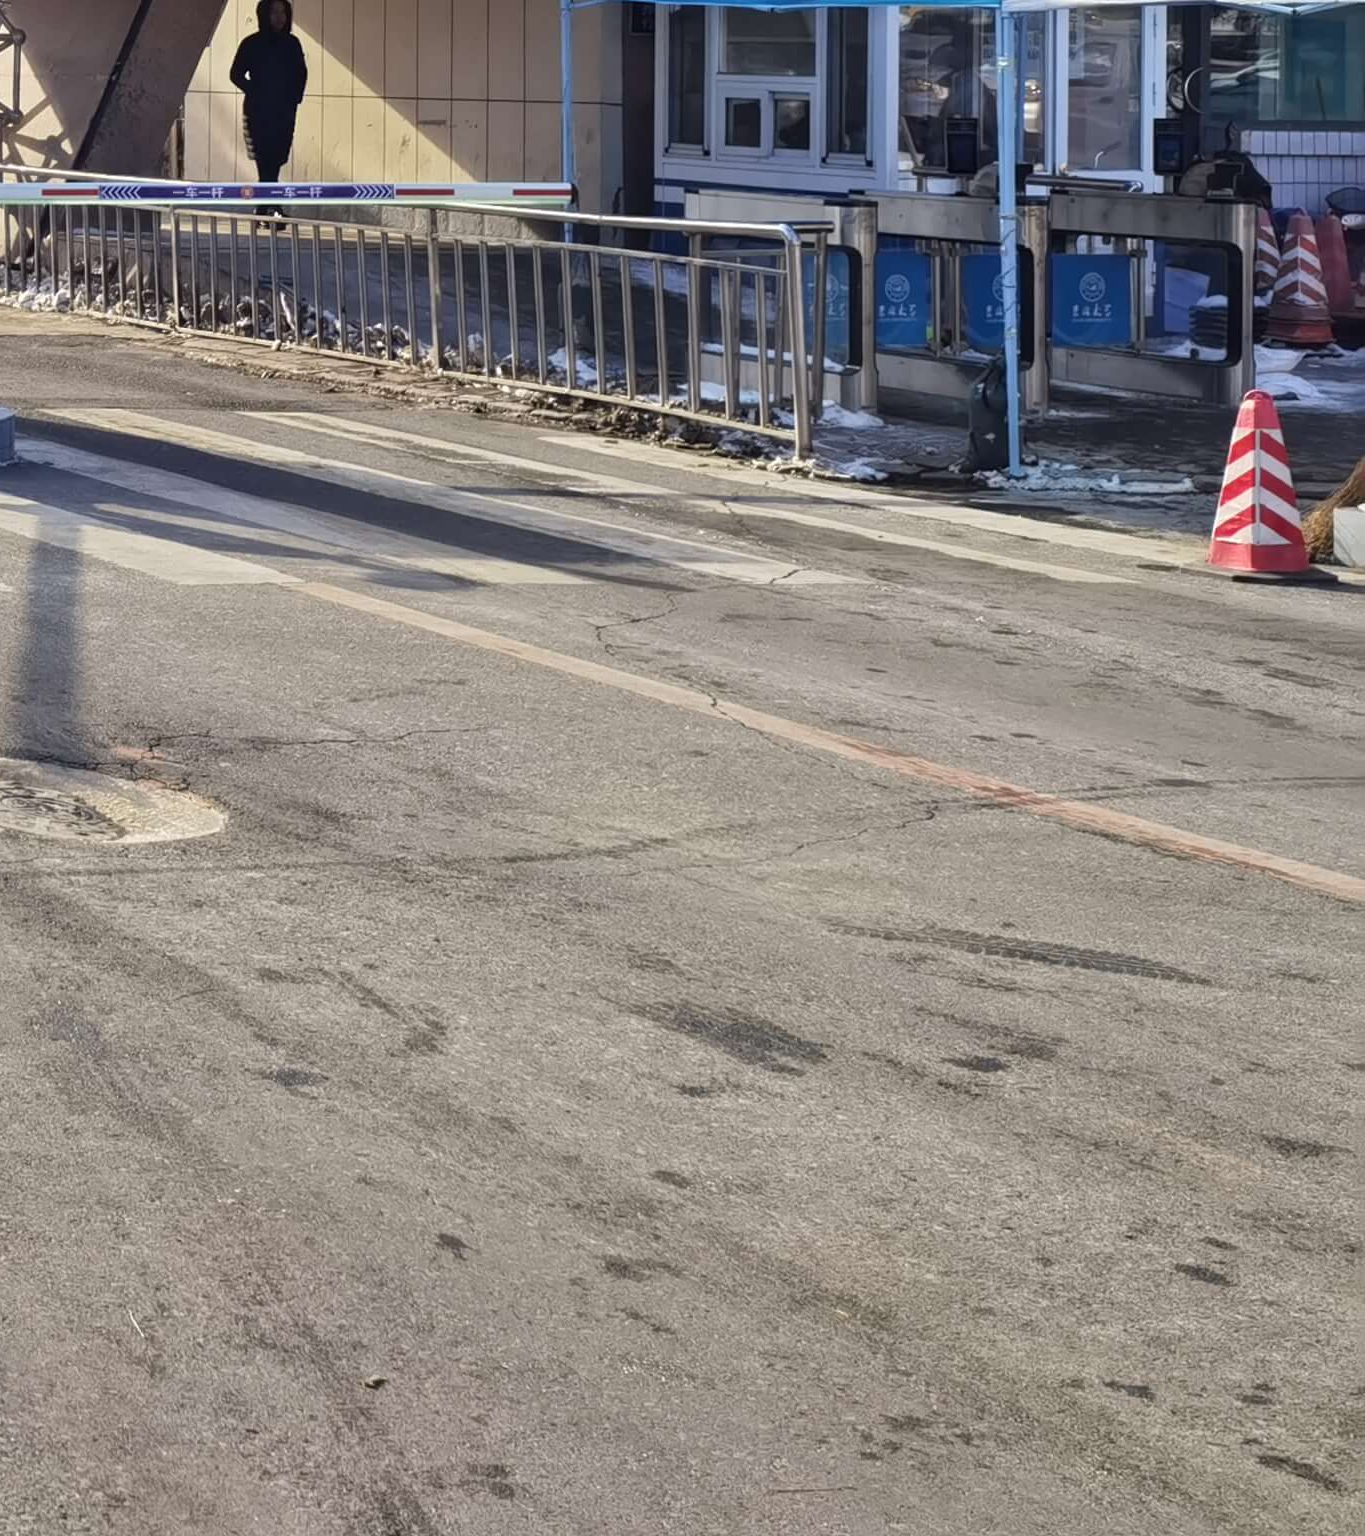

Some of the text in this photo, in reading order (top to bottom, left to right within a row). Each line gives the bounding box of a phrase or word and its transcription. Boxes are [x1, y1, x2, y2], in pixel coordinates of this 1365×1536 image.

[172, 186, 225, 199] 一车一杆
[270, 186, 323, 199] 一车一杆
